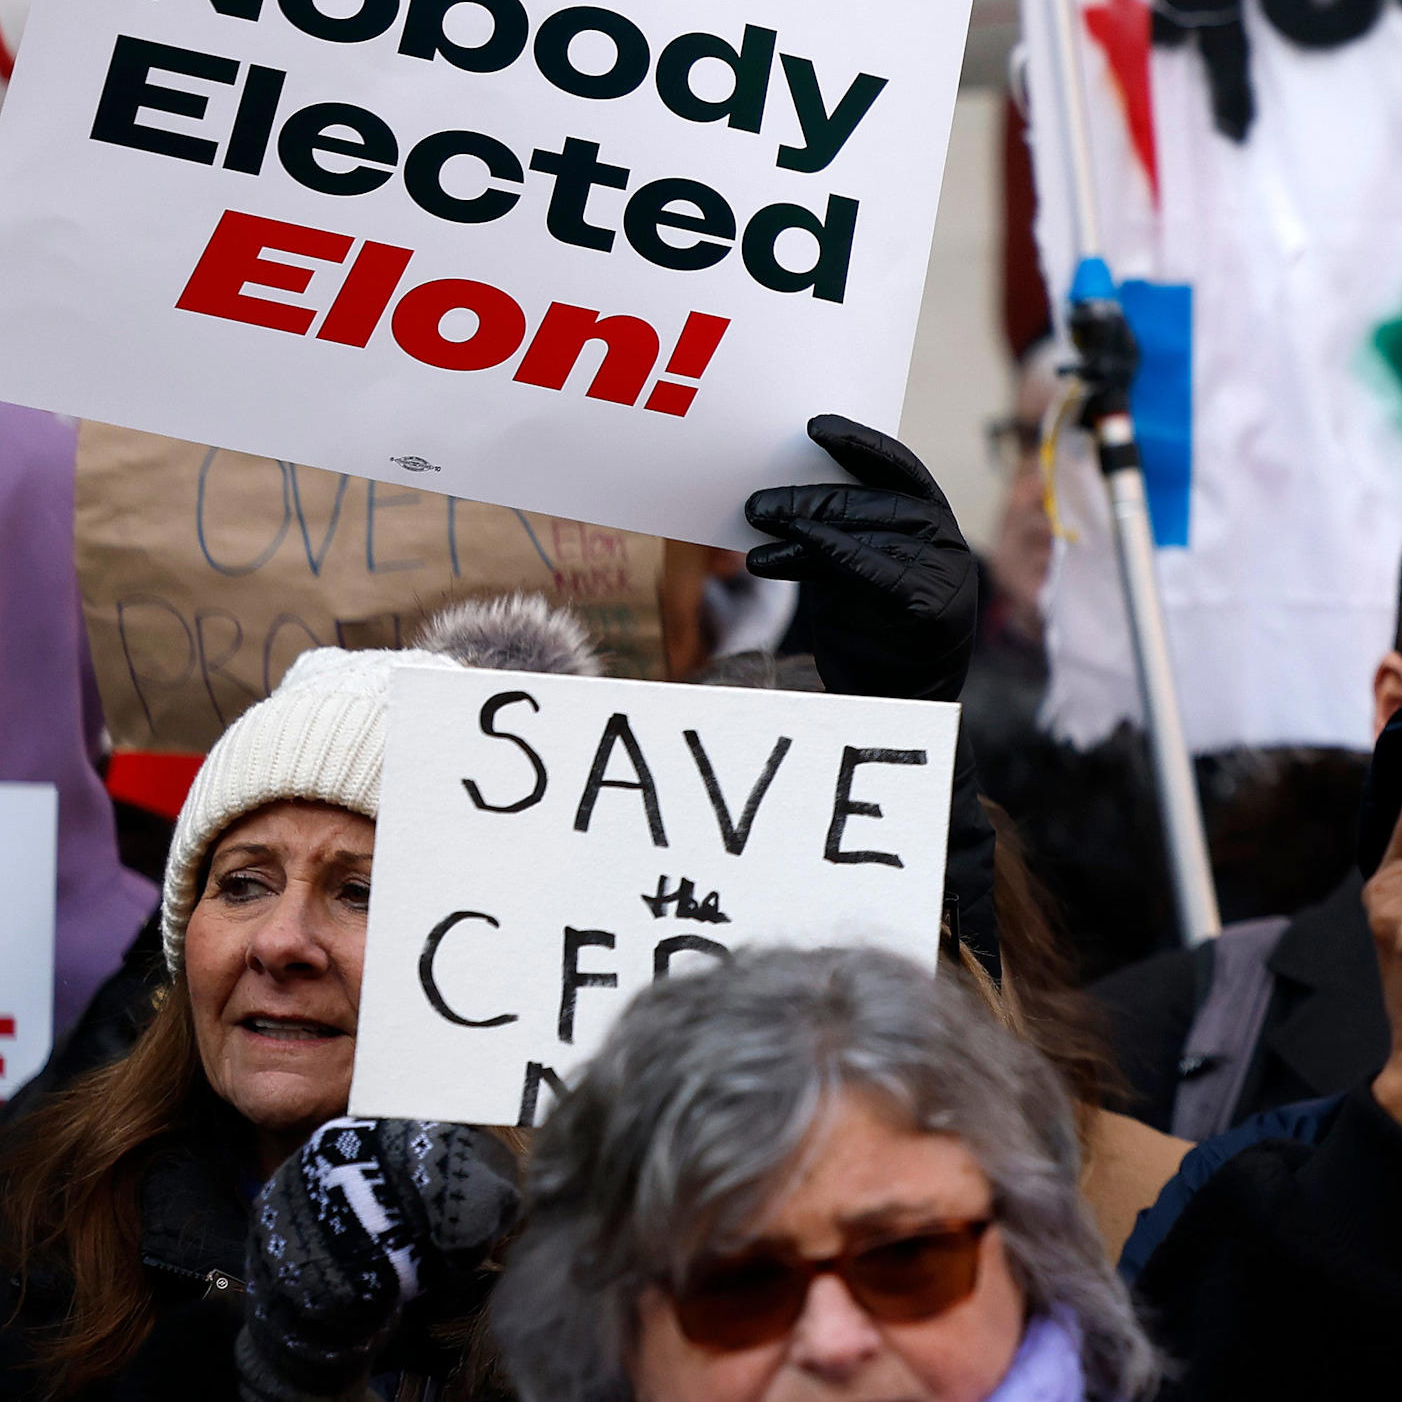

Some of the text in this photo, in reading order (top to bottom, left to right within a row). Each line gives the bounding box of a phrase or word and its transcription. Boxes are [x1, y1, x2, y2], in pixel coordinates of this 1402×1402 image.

[89, 34, 861, 304] Elected
[175, 208, 732, 418] Elon!
[462, 690, 928, 869] SAVE
[641, 875, 731, 925] the
